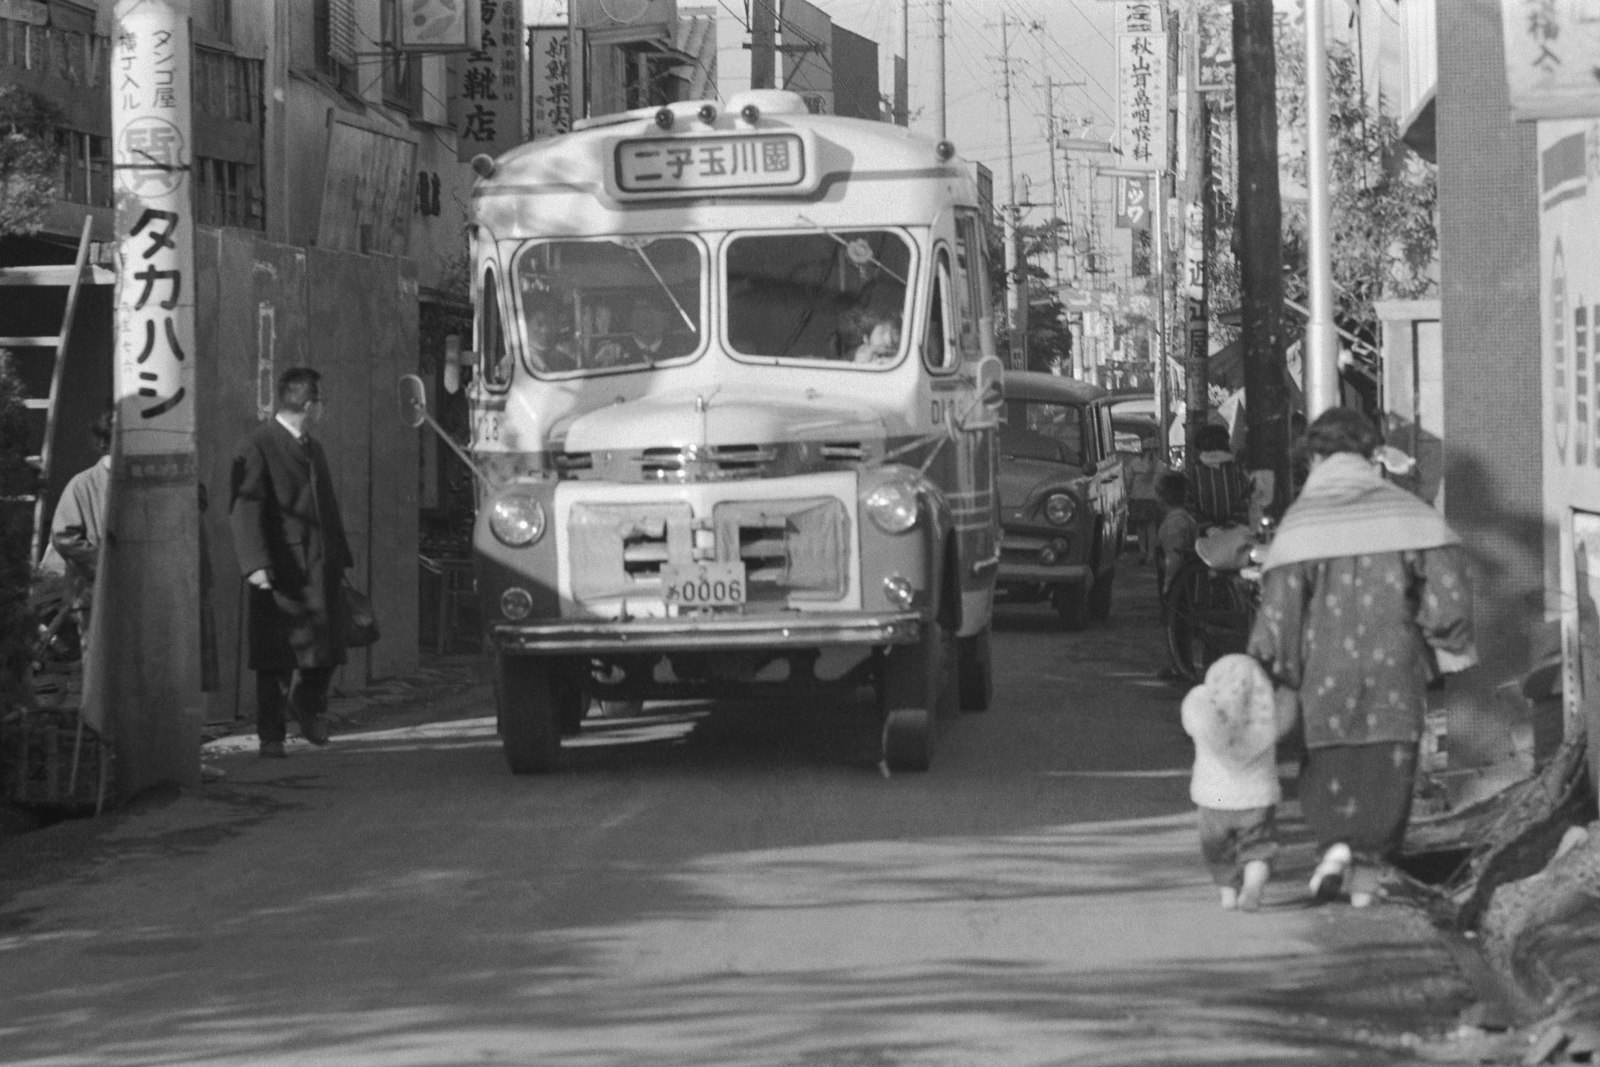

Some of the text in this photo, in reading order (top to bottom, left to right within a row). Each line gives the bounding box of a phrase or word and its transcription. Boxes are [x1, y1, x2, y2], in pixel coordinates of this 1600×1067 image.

[634, 141, 791, 181] 二子玉川園
[129, 207, 186, 420] タカハシ
